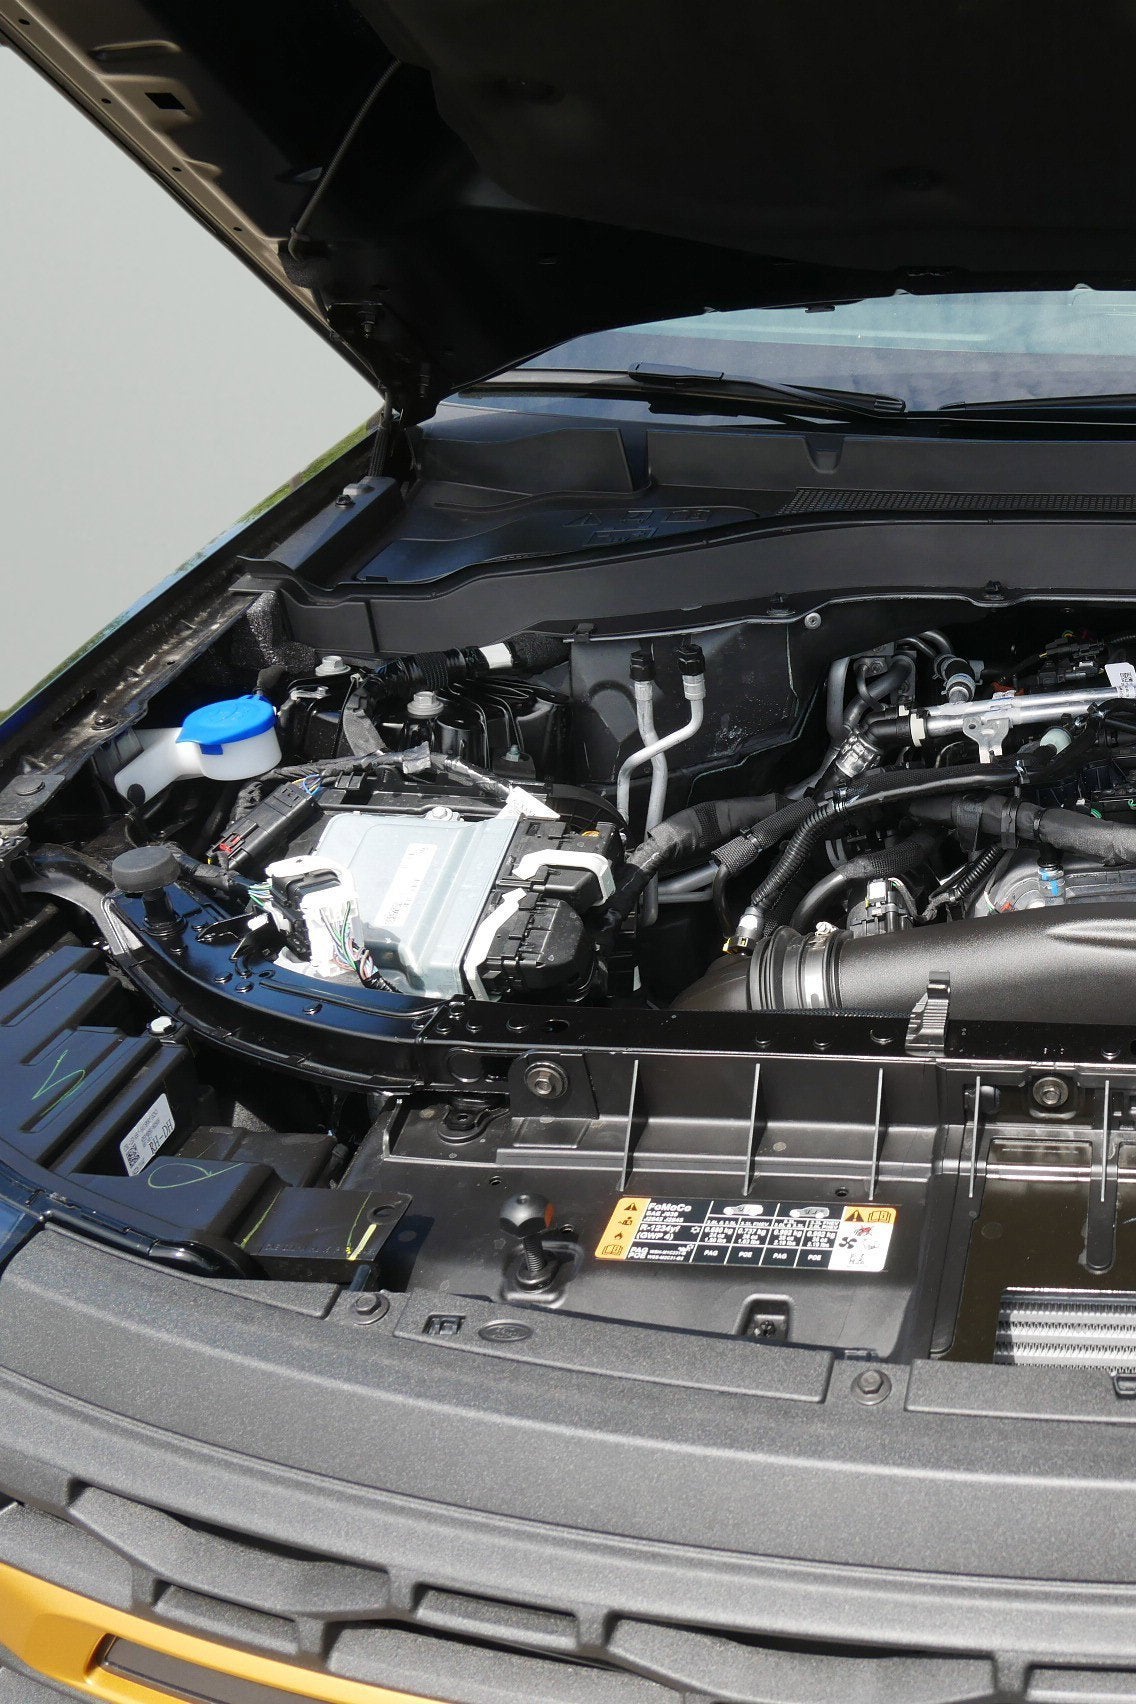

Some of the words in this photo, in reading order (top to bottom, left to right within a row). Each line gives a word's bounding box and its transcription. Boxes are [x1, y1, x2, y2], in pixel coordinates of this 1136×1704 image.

[648, 1202, 692, 1212] FoMoCo
[639, 1223, 681, 1233] R-1234yf
[629, 1246, 649, 1254] PAG
[772, 1252, 788, 1260] PAG
